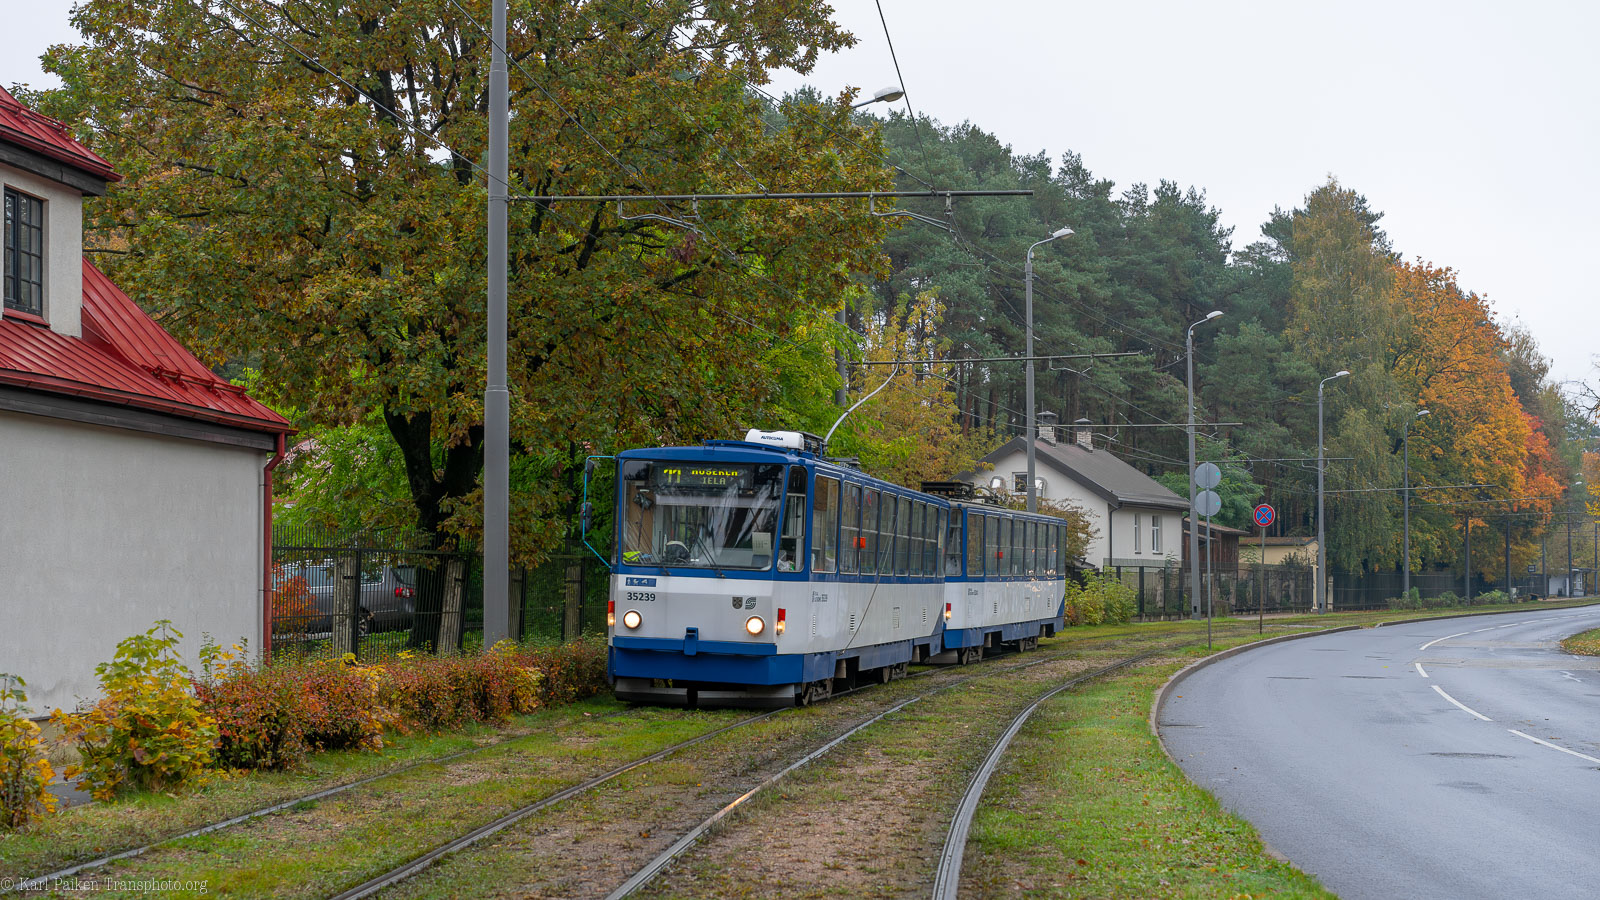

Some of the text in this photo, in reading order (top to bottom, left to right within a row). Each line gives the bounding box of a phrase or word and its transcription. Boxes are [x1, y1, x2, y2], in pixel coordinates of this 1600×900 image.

[663, 469, 681, 484] 11
[702, 477, 726, 485] IELA
[626, 591, 656, 602] 35239
